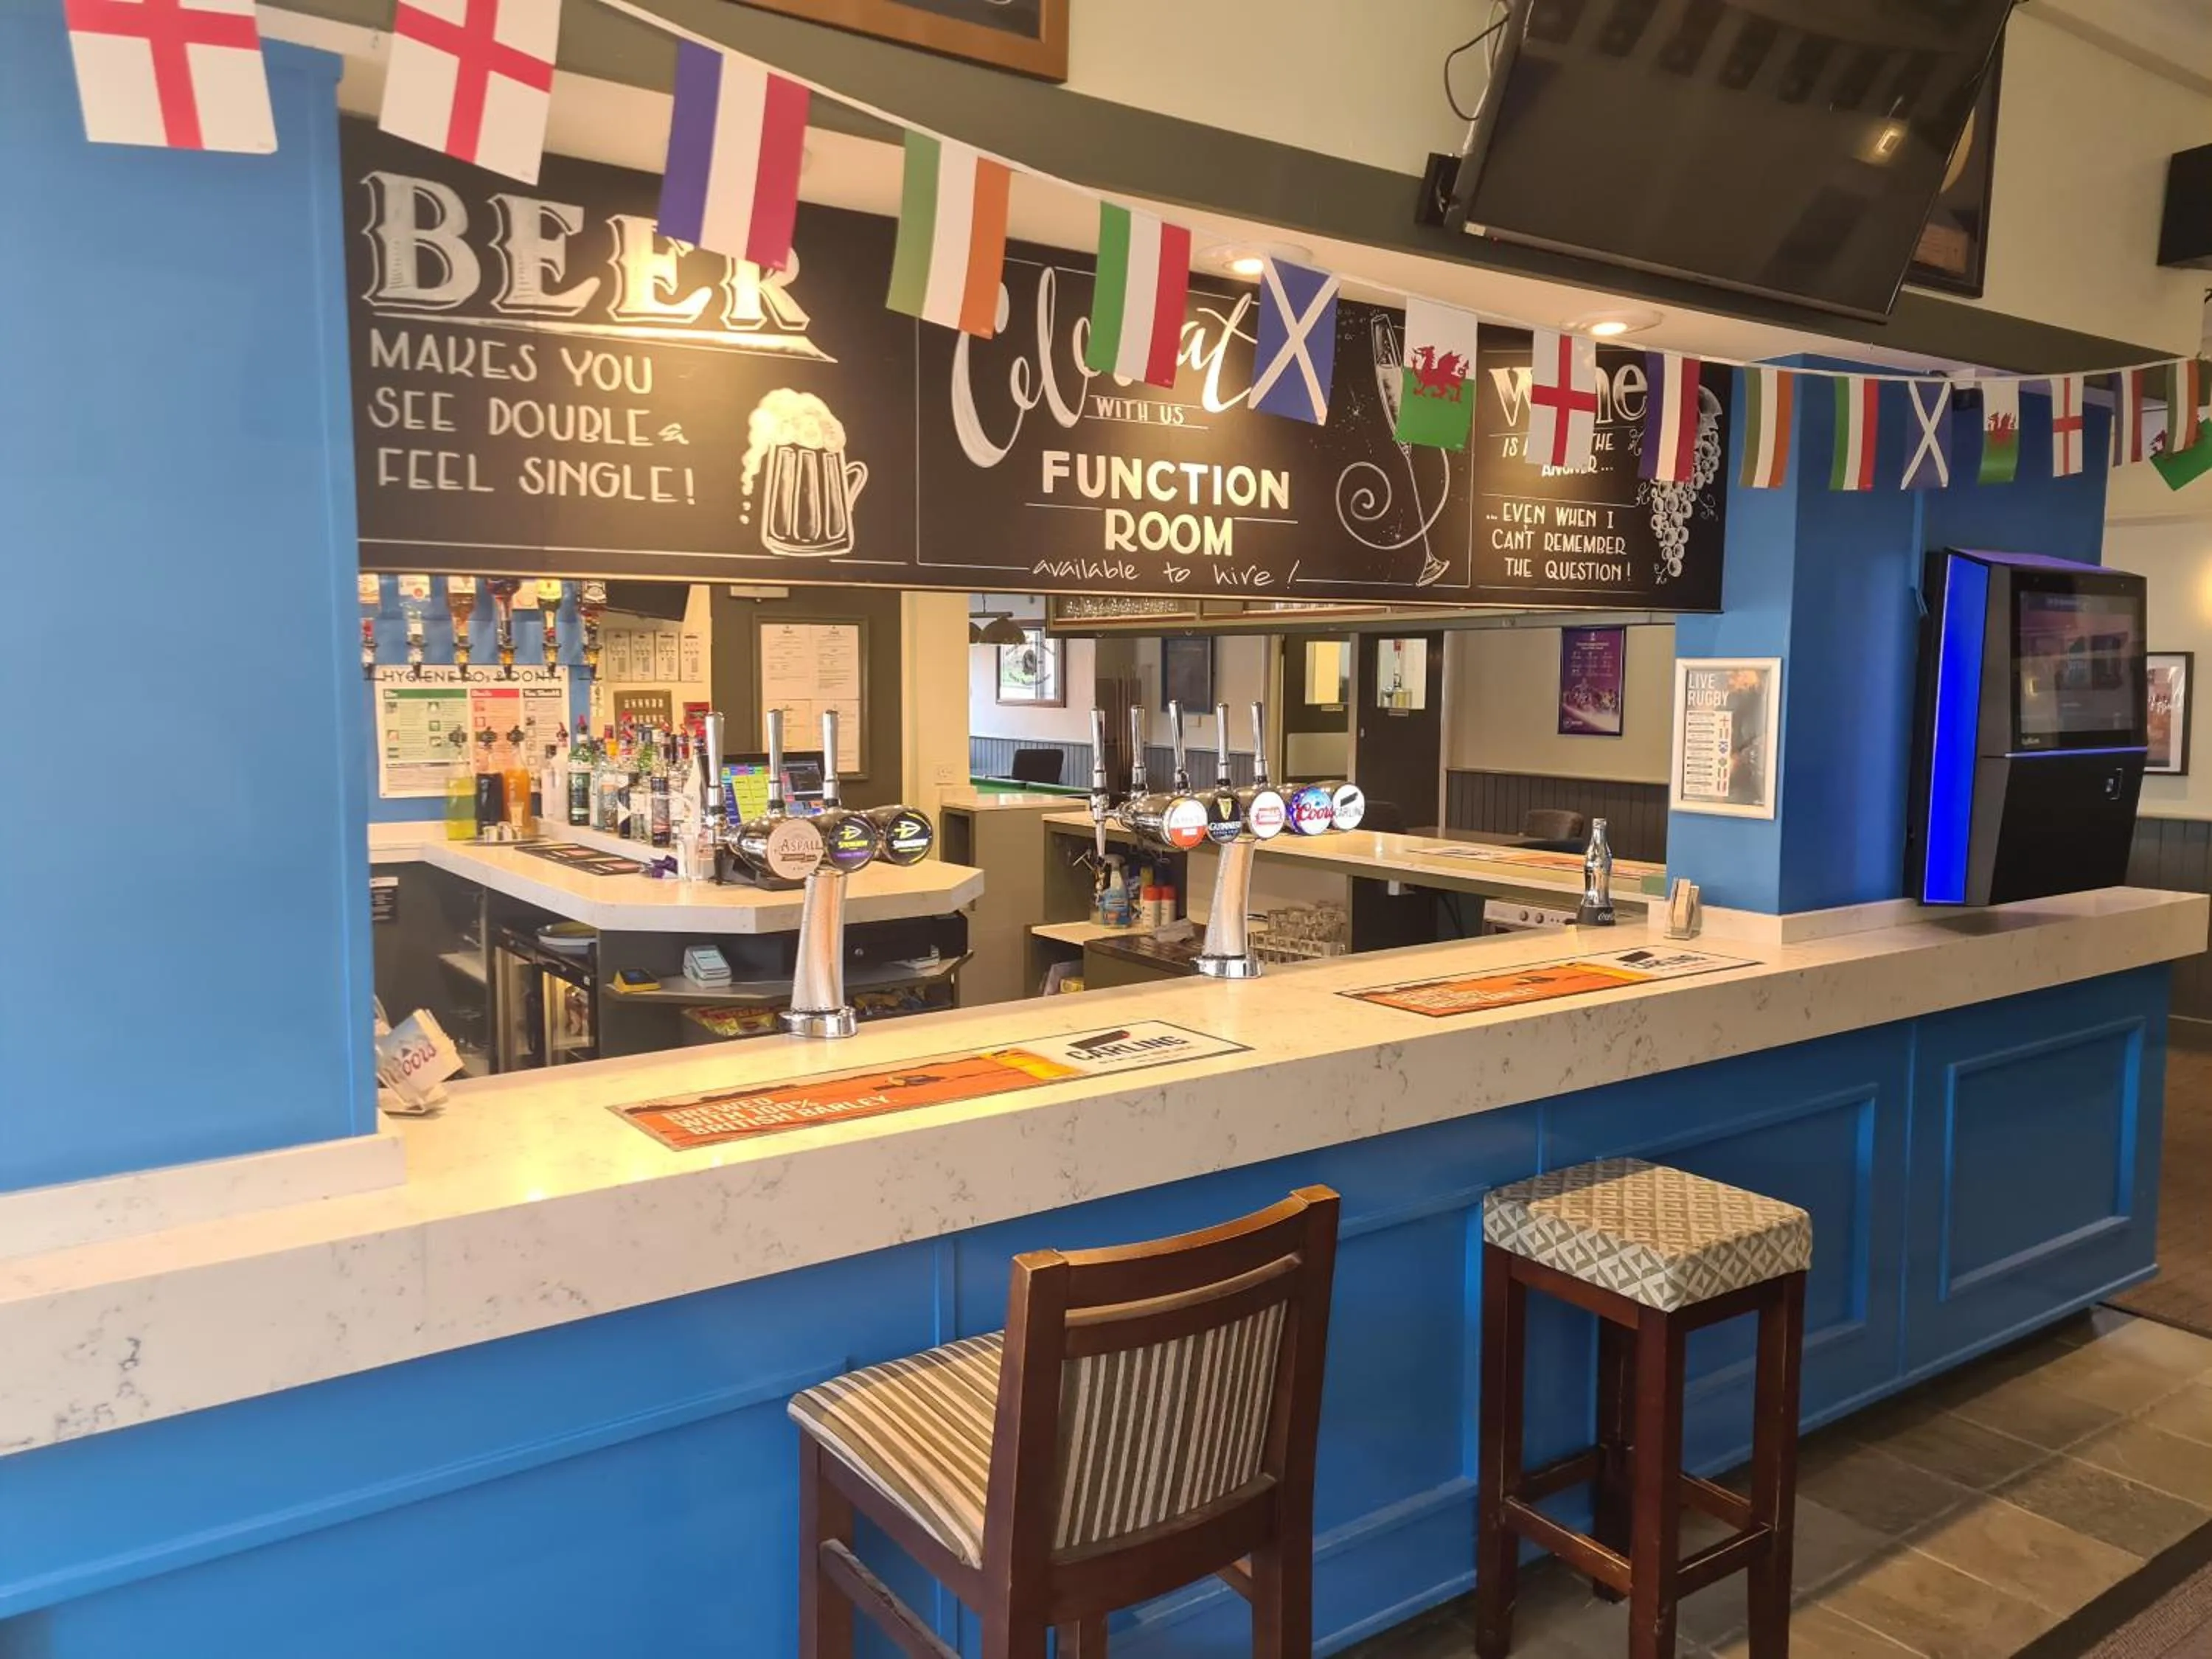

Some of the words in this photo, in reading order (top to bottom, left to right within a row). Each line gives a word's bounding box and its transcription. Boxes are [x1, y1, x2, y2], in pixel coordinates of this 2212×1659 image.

[369, 328, 537, 382] MAKES
[560, 347, 653, 394] YOU
[369, 387, 457, 432] SEE
[488, 397, 654, 446] DOUBLE
[1096, 397, 1148, 422] WITH
[1159, 406, 1185, 425] US
[1503, 437, 1518, 458] IS
[378, 448, 494, 493] FEEL
[519, 456, 695, 506] SINGLE!
[1042, 451, 1290, 509] FUNCTION
[1556, 507, 1596, 528] WHEN
[1607, 511, 1613, 529] I
[1105, 509, 1232, 556] ROOM
[1544, 532, 1627, 555] REMEMBER
[1033, 559, 1139, 581] available
[1164, 560, 1191, 582] to
[1504, 557, 1533, 577] THE
[1545, 560, 1631, 582] QUESTION!
[1688, 673, 1716, 689] LIVE
[1688, 689, 1730, 706] RUGBY
[1065, 1035, 1190, 1061] CARLING
[661, 1096, 773, 1121] BREWED
[678, 1110, 737, 1129] WITH
[748, 1098, 819, 1120] 100%
[686, 1112, 796, 1135] BRITISH
